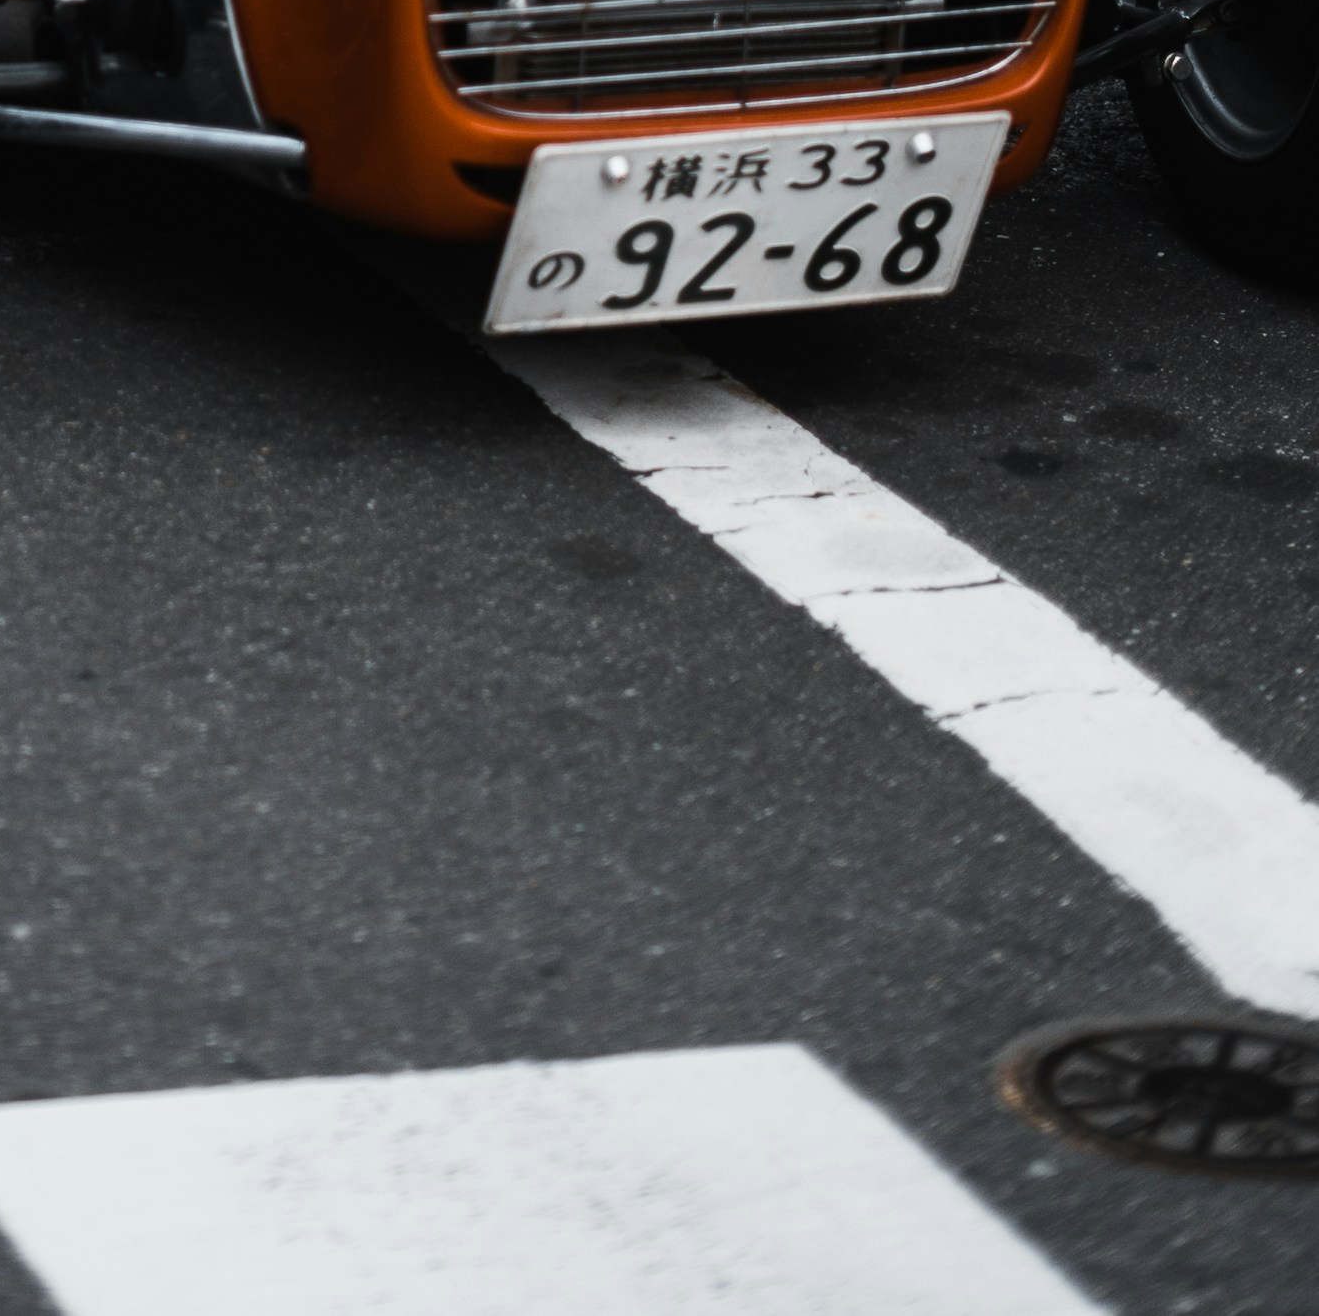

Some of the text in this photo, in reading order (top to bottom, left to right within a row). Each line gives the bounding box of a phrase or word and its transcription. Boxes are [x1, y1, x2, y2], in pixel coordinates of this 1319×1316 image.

[642, 139, 890, 202] 横浜 33
[528, 195, 953, 310] の 92-68
